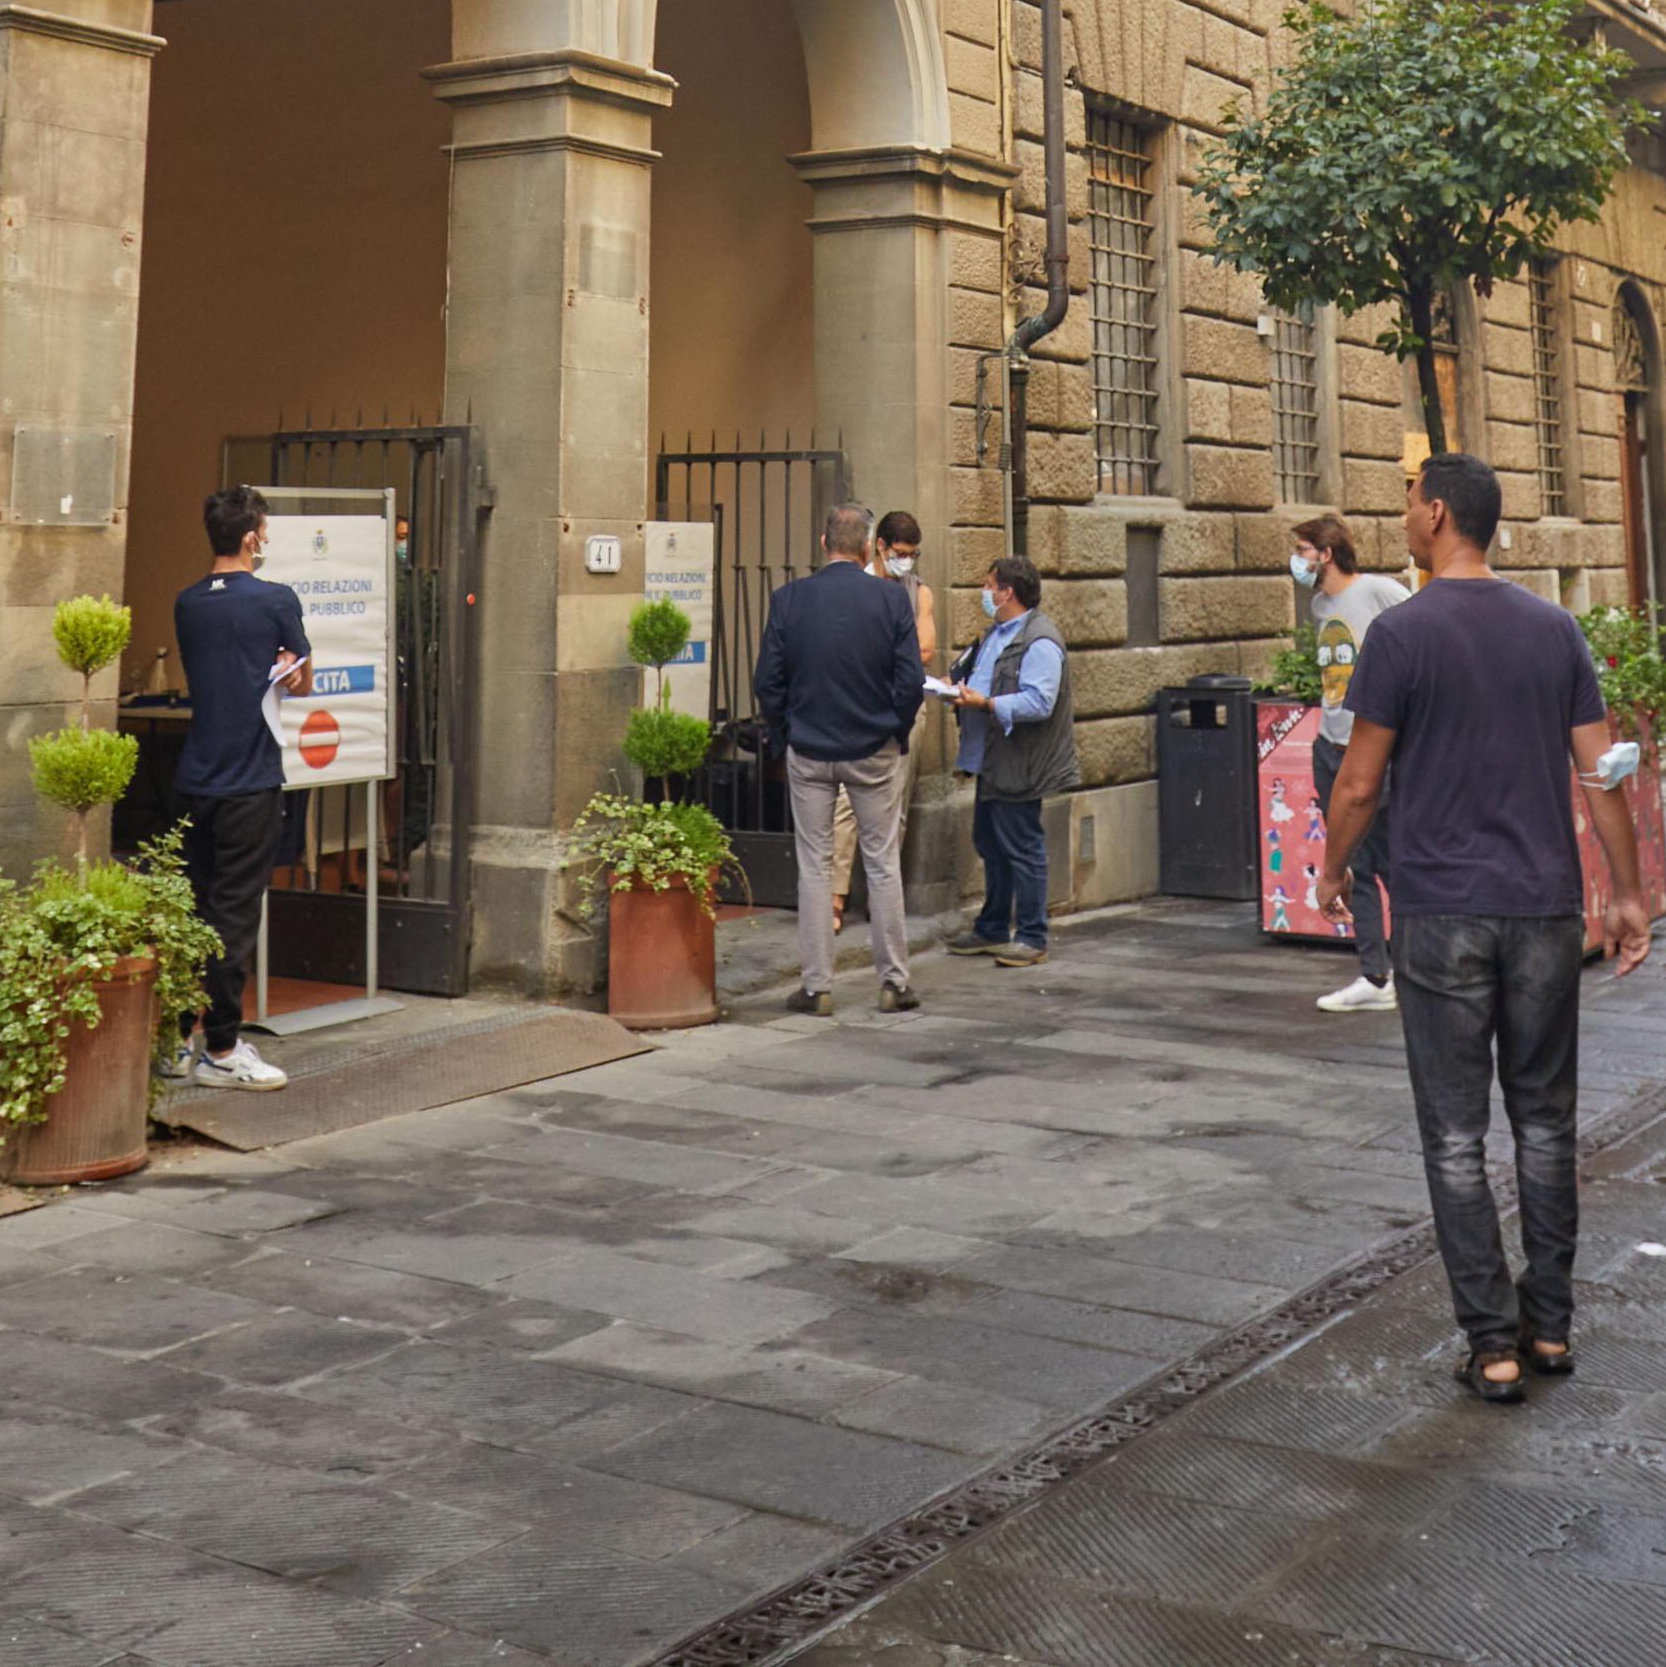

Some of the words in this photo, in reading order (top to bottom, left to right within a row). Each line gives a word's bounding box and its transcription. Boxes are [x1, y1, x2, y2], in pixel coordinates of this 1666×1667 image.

[595, 544, 612, 565] 41
[313, 581, 371, 594] RELAZIONI
[311, 601, 364, 615] PUBBLICO
[313, 671, 350, 692] CITA
